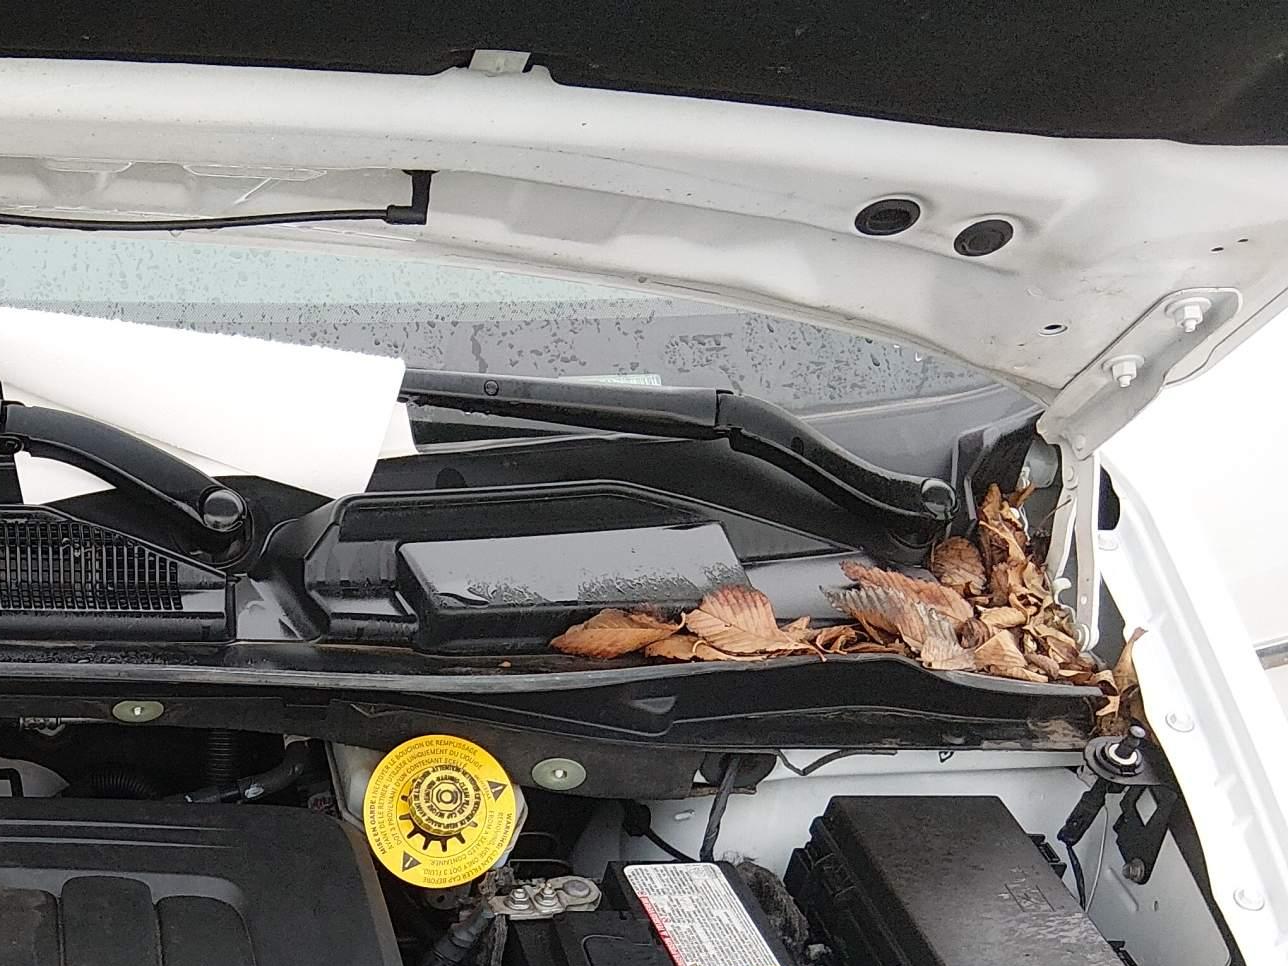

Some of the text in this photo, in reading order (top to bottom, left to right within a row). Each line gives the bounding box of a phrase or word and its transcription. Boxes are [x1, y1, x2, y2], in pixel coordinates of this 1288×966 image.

[395, 742, 424, 759] BOUCHON
[435, 740, 477, 755] REMPLISSAGE
[392, 832, 402, 845] DOT
[406, 758, 442, 773] CONTENANT
[371, 826, 378, 836] EN
[375, 837, 387, 854] MISE
[462, 856, 478, 868] ONLY
[480, 849, 497, 867] CLEAN
[461, 865, 481, 878] FILLER
